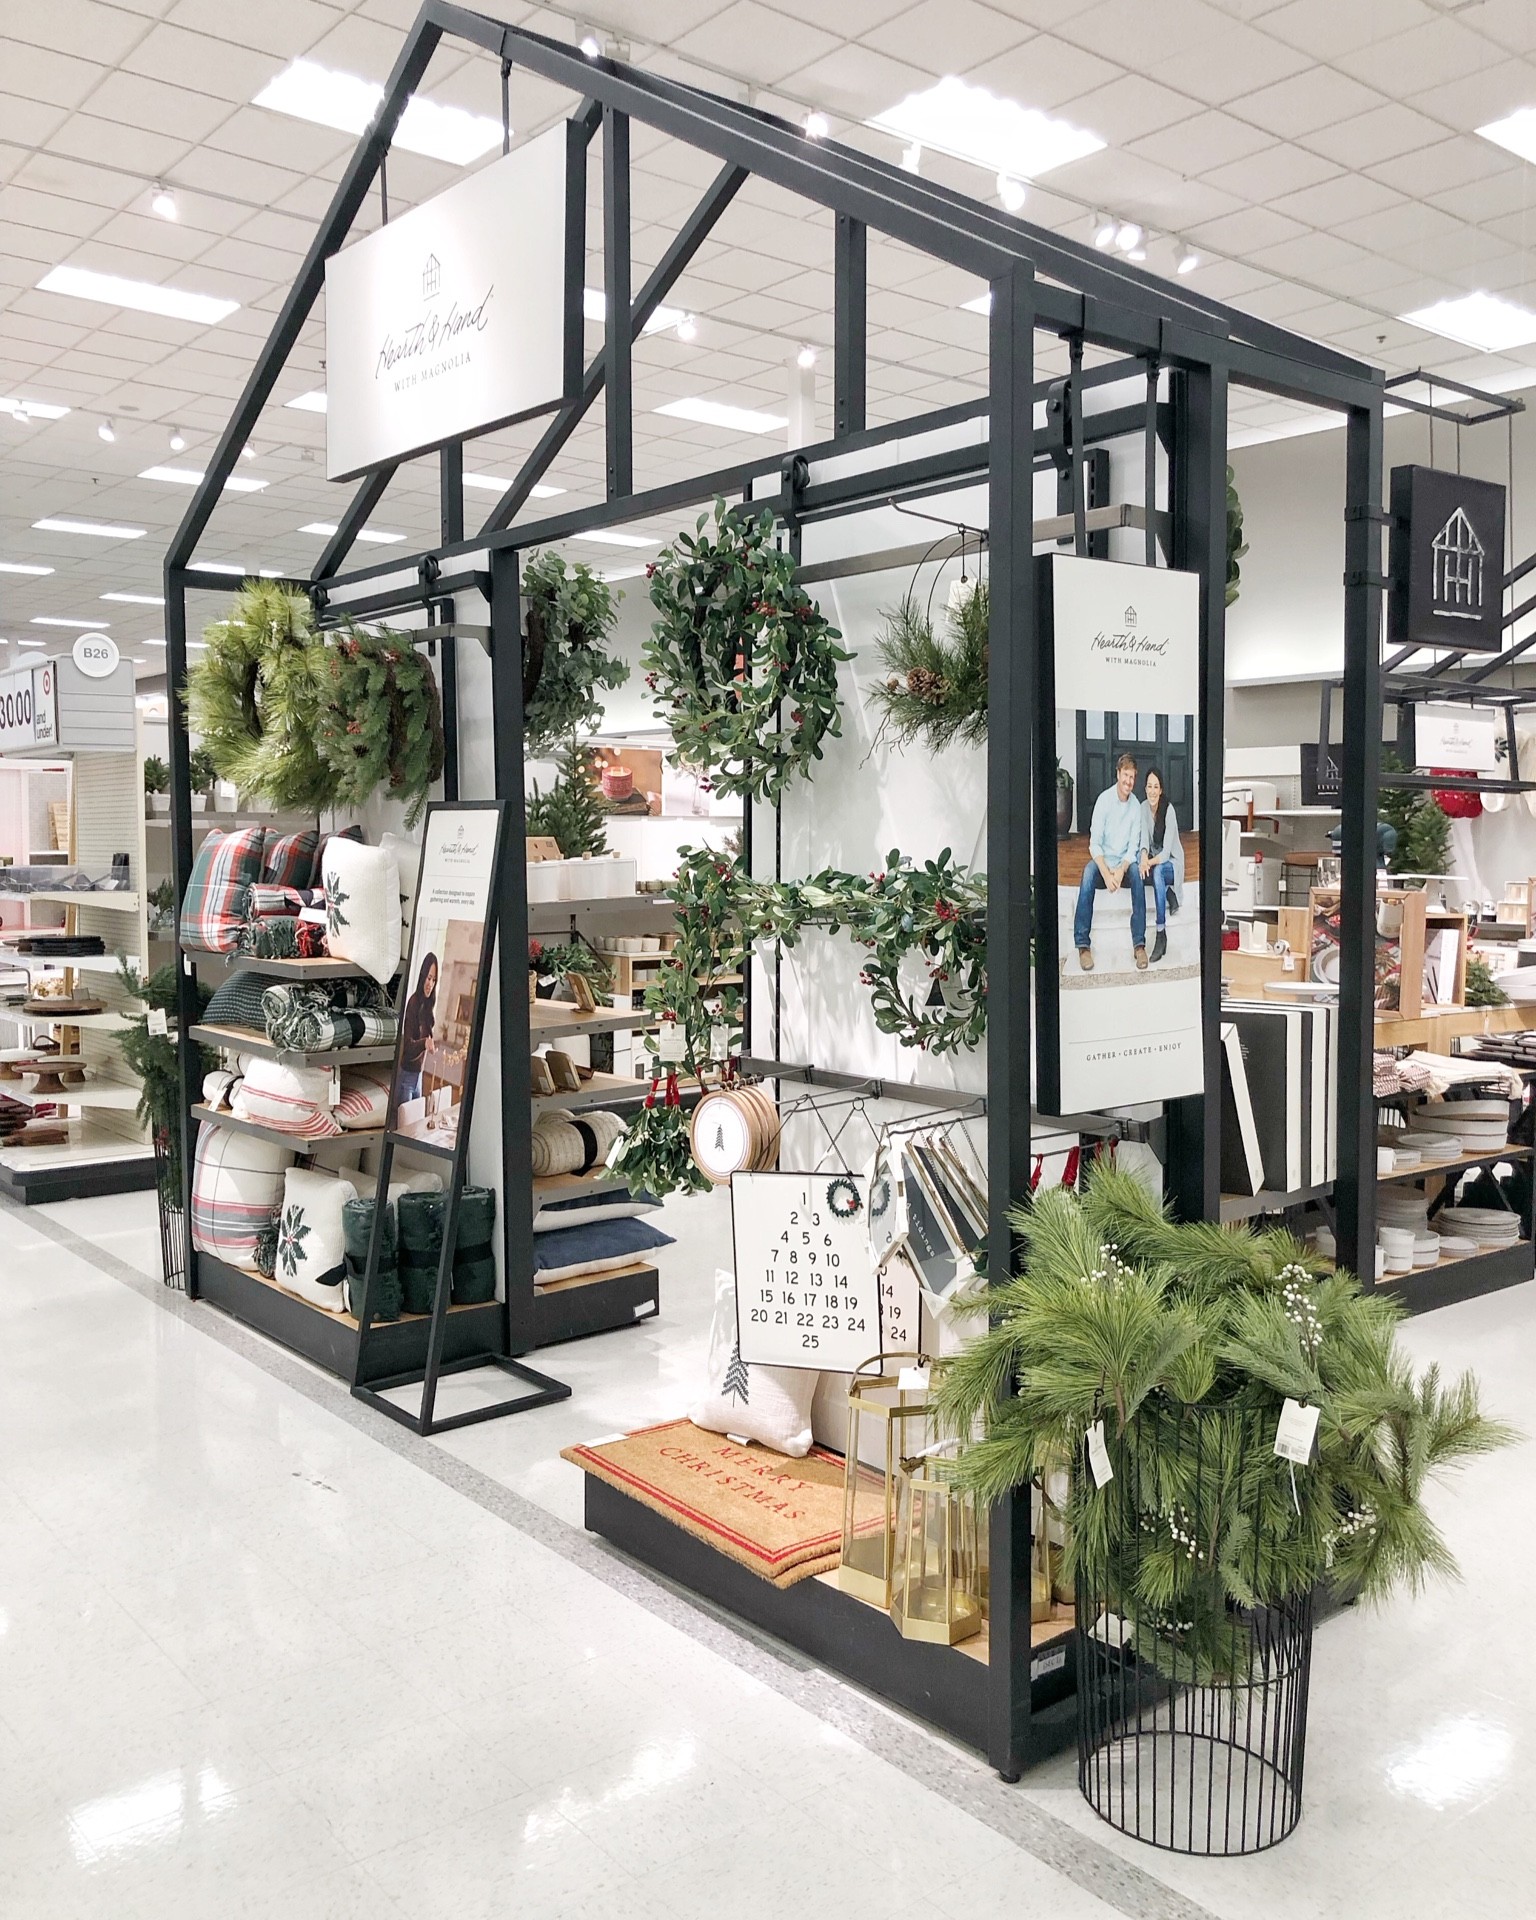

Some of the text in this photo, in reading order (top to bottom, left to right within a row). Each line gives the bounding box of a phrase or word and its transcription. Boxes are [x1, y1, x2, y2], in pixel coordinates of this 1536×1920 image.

[375, 284, 494, 379] Hearth & Hand
[393, 352, 471, 393] WITH MAGNOLIA
[83, 647, 109, 659] B26
[1090, 631, 1169, 656] Hearth & Hand
[1124, 658, 1157, 667] MAGNOLIA
[36, 709, 46, 725] and
[1086, 1042, 1182, 1062] GATHER CREATE ENJOY
[790, 1211, 821, 1227] 2 3
[780, 1230, 832, 1247] 4 5 6
[912, 1213, 936, 1258] tidings
[771, 1249, 840, 1268] 7 8 9 10
[766, 1269, 848, 1289] 11 12 13 14
[760, 1289, 858, 1310] 15 16 17 18 19
[881, 1283, 894, 1298] 14
[751, 1308, 866, 1332] 20 21 22 23 24
[889, 1305, 902, 1320] 19
[802, 1334, 820, 1349] 25
[890, 1326, 907, 1342] 24
[711, 1446, 814, 1492] MERRY
[659, 1446, 806, 1519] CHRISTMAS
